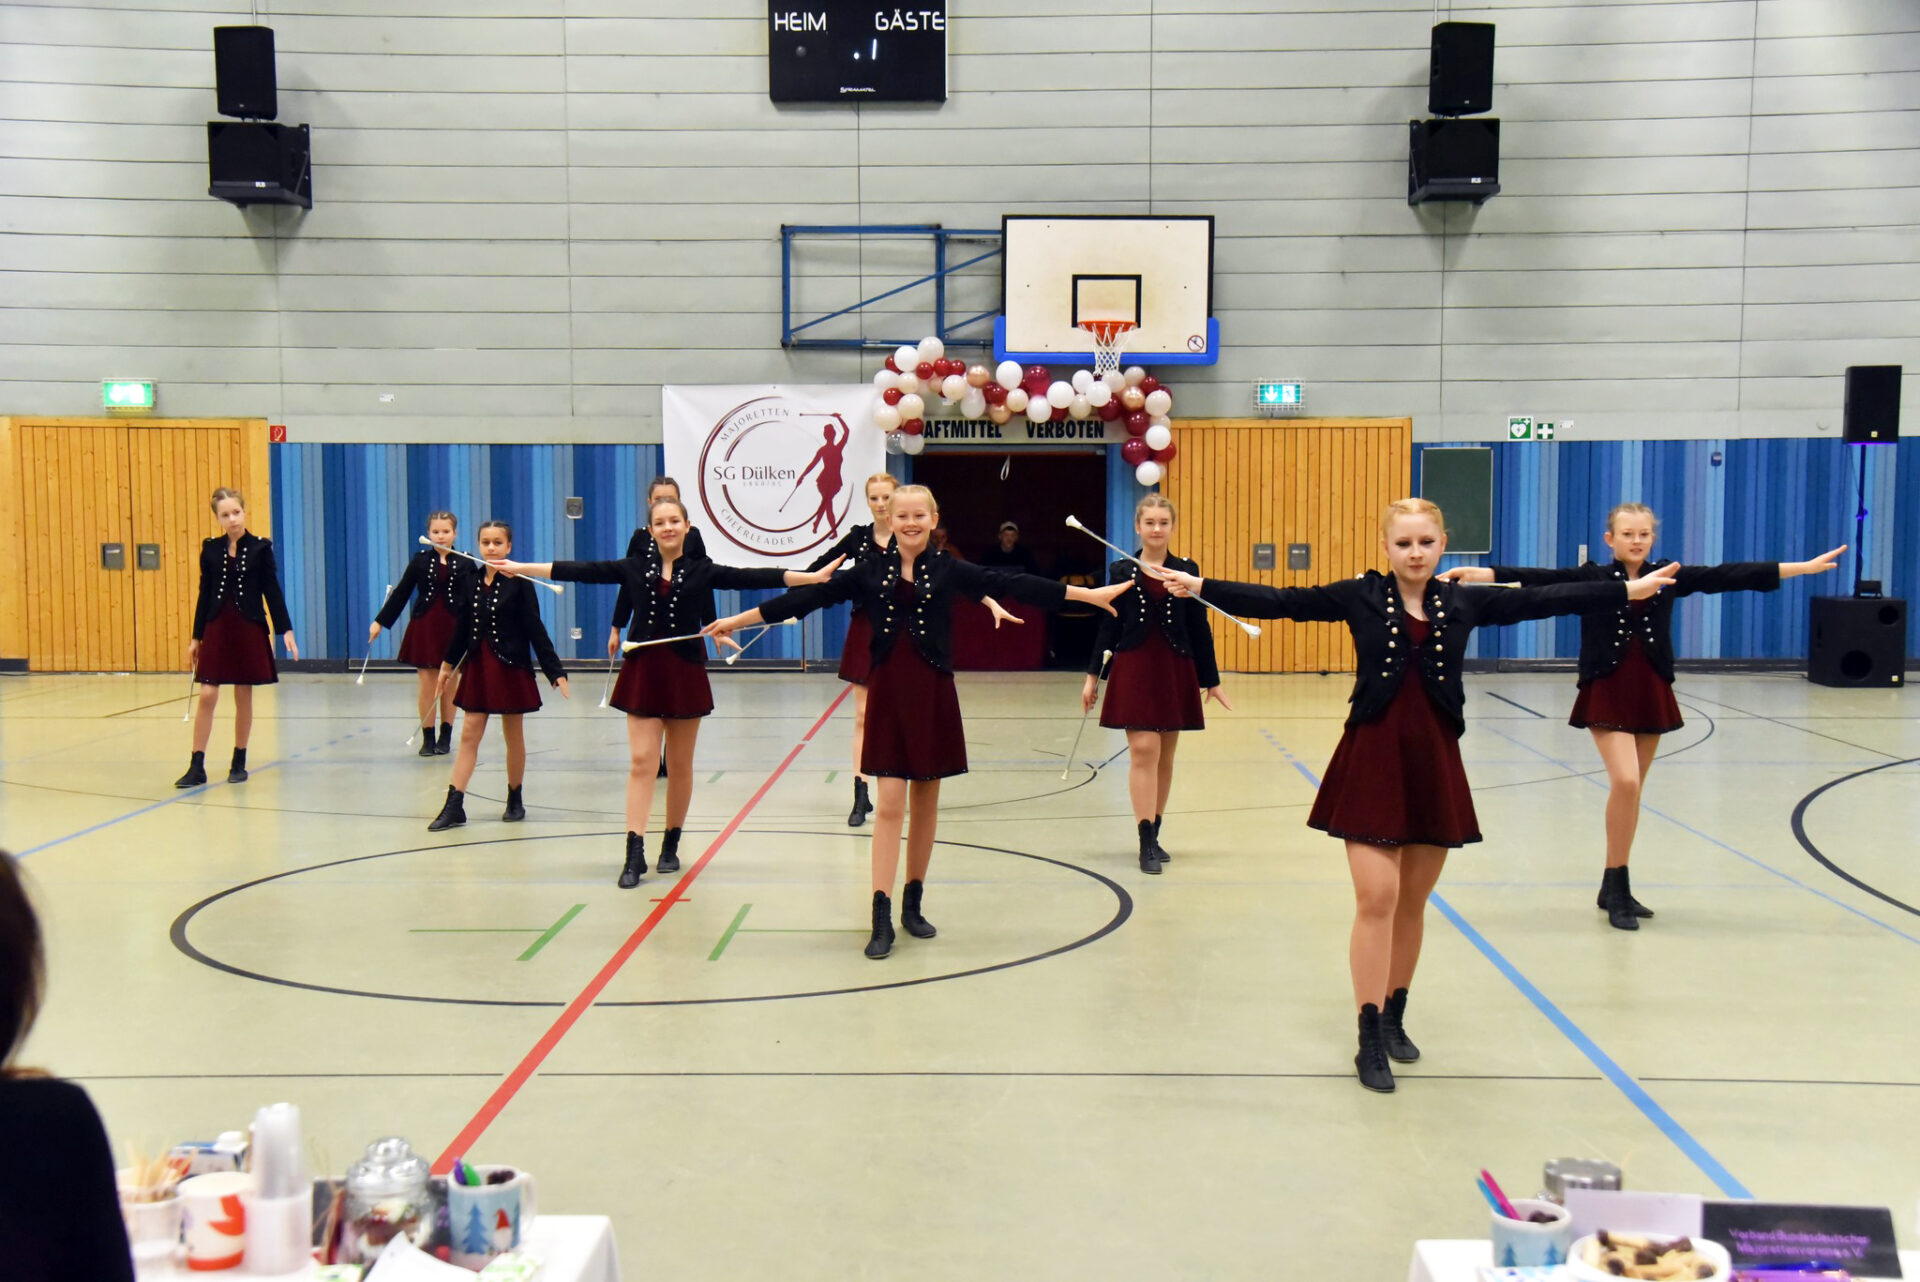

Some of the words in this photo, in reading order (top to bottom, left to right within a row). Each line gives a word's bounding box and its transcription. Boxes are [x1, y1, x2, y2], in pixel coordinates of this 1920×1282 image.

[774, 12, 827, 32] HEIM
[875, 9, 945, 31] GÄSTE
[720, 407, 790, 442] MAJORETTEN
[922, 420, 1003, 439] AFTMITTEL
[1025, 420, 1105, 439] VERBOTEN
[713, 466, 736, 481] SG
[742, 465, 796, 481] Dülken
[720, 508, 795, 546] CHEERLEADER
